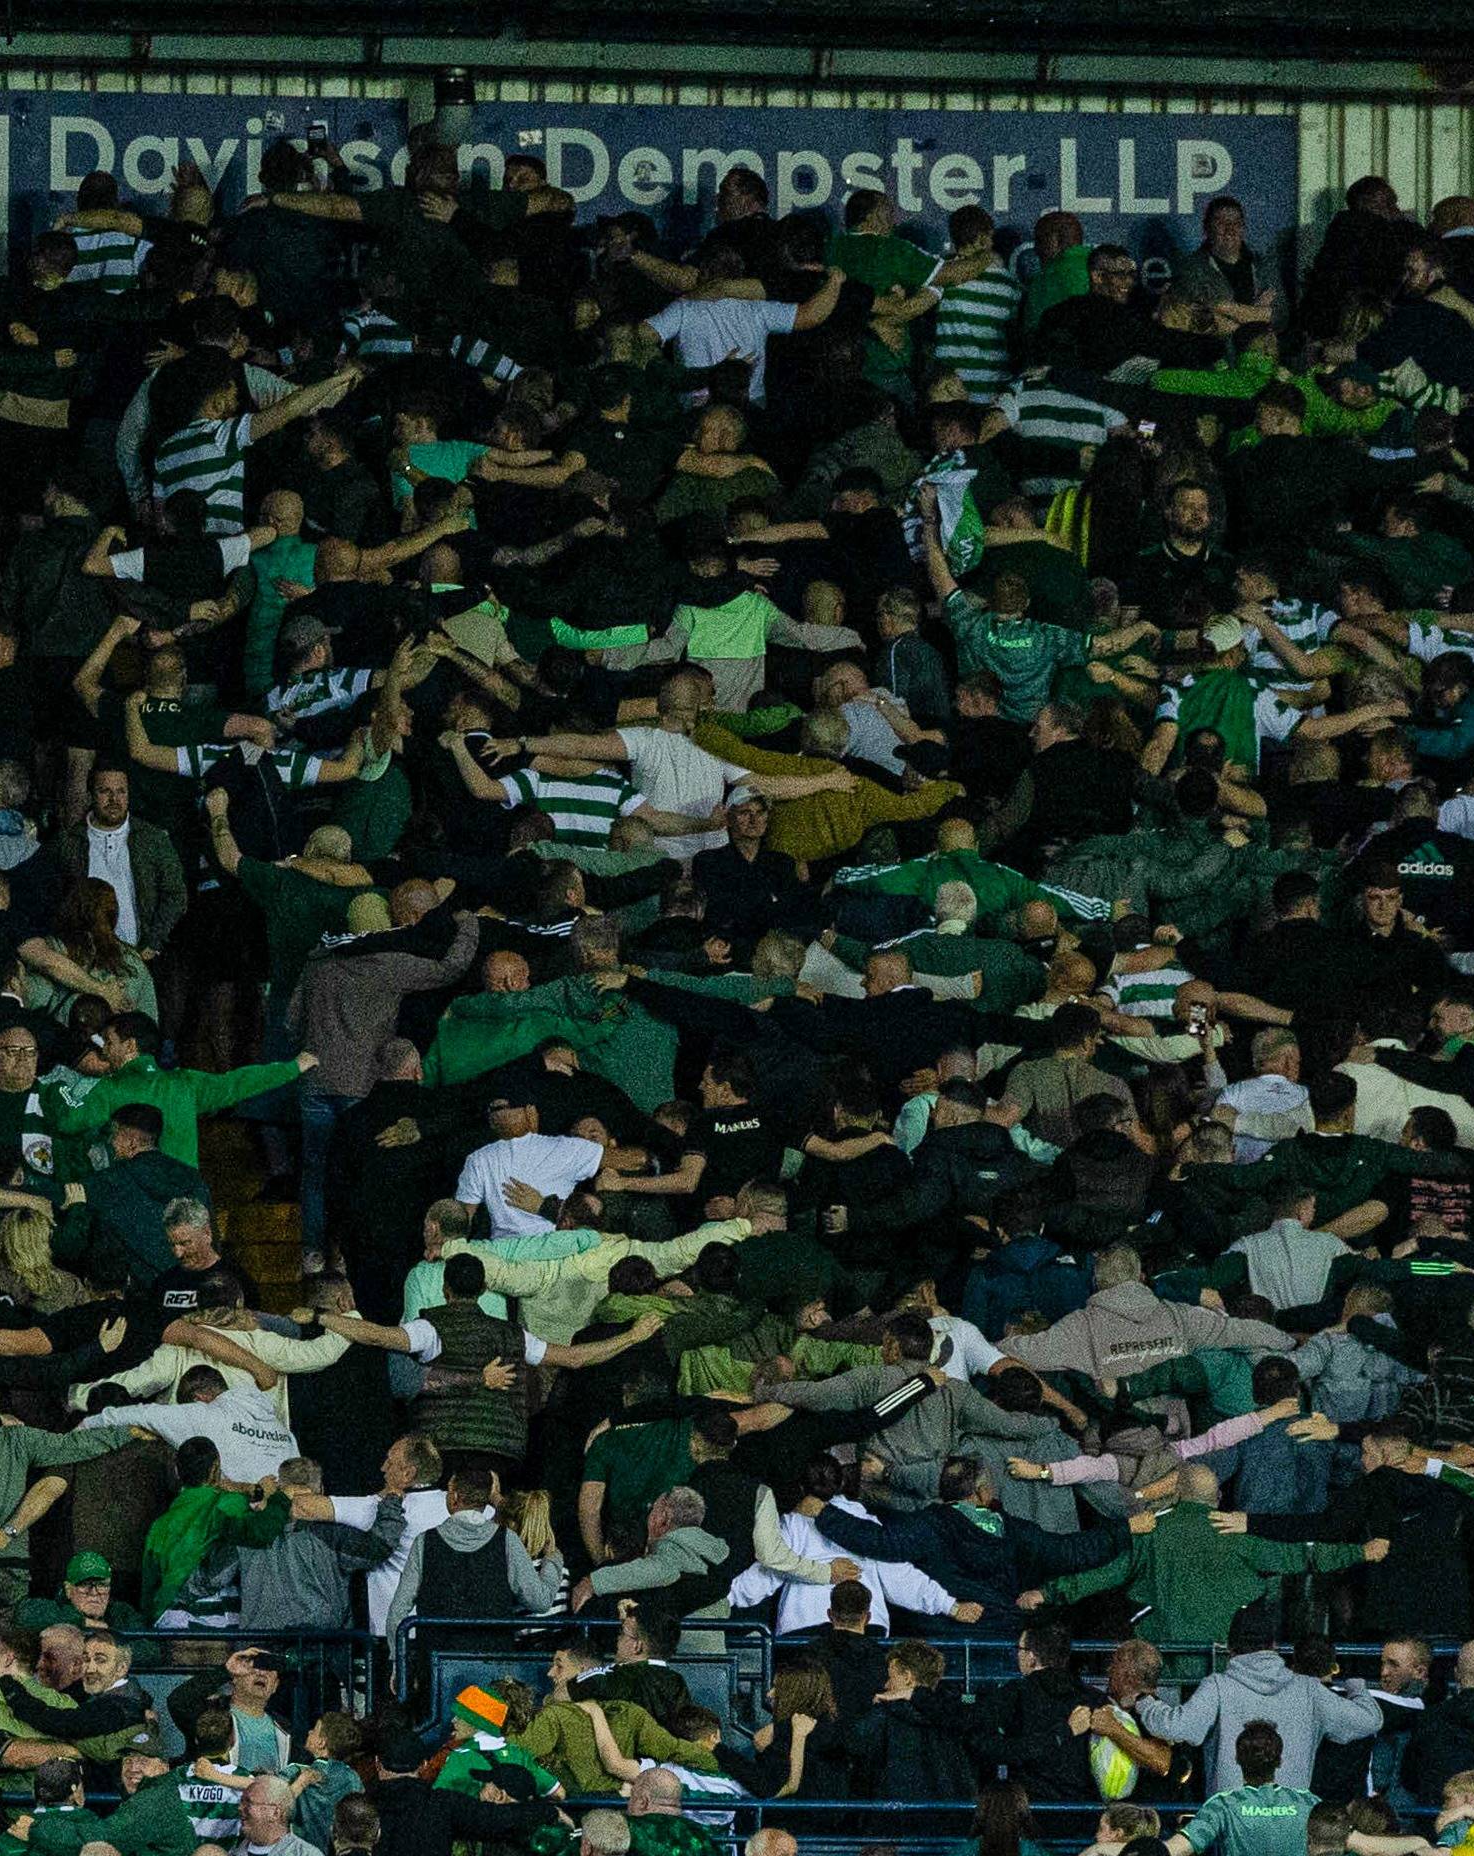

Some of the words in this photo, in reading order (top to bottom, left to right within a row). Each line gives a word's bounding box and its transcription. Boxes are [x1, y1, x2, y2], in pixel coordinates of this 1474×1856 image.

[51, 114, 505, 194] Davison
[547, 127, 1026, 216] Dempster
[1060, 138, 1234, 216] LLP
[1397, 862, 1455, 878] adidas
[1110, 1336, 1175, 1355] REPRESENT
[188, 1786, 224, 1802] KYOGO
[1241, 1805, 1299, 1817] MAGNERS
